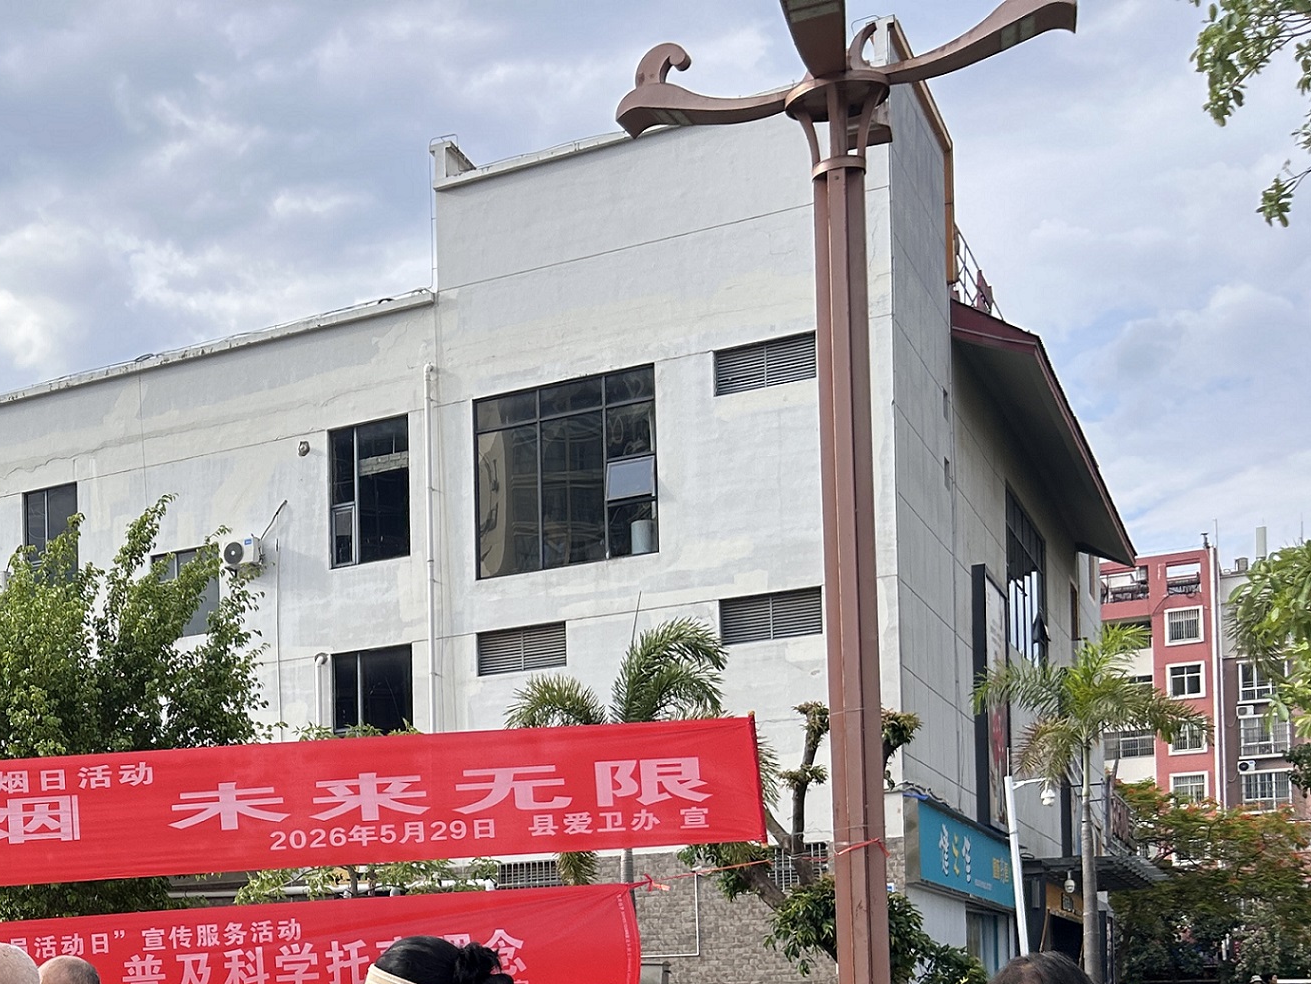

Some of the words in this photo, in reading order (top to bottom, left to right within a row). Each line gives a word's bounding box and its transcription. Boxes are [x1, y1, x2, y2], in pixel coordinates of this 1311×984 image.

[168, 757, 712, 831] 未来无限
[269, 818, 496, 851] 2026年5月29日
[529, 809, 661, 837] 县爱卫办
[679, 806, 710, 829] 宣
